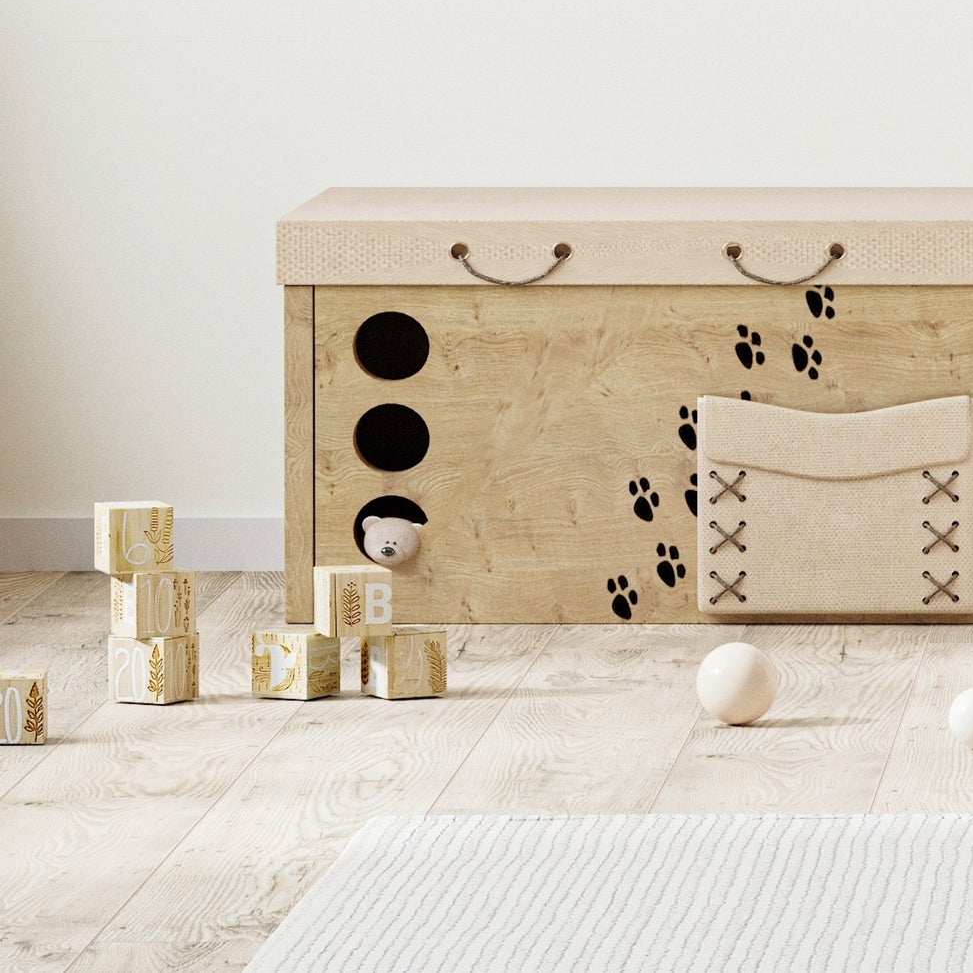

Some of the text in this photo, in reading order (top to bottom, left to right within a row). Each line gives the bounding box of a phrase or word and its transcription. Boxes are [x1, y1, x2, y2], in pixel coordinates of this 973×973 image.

[123, 511, 151, 565] 6
[140, 577, 173, 634] 10
[365, 582, 393, 625] B
[115, 646, 146, 702] 20
[0, 687, 22, 744] 0
